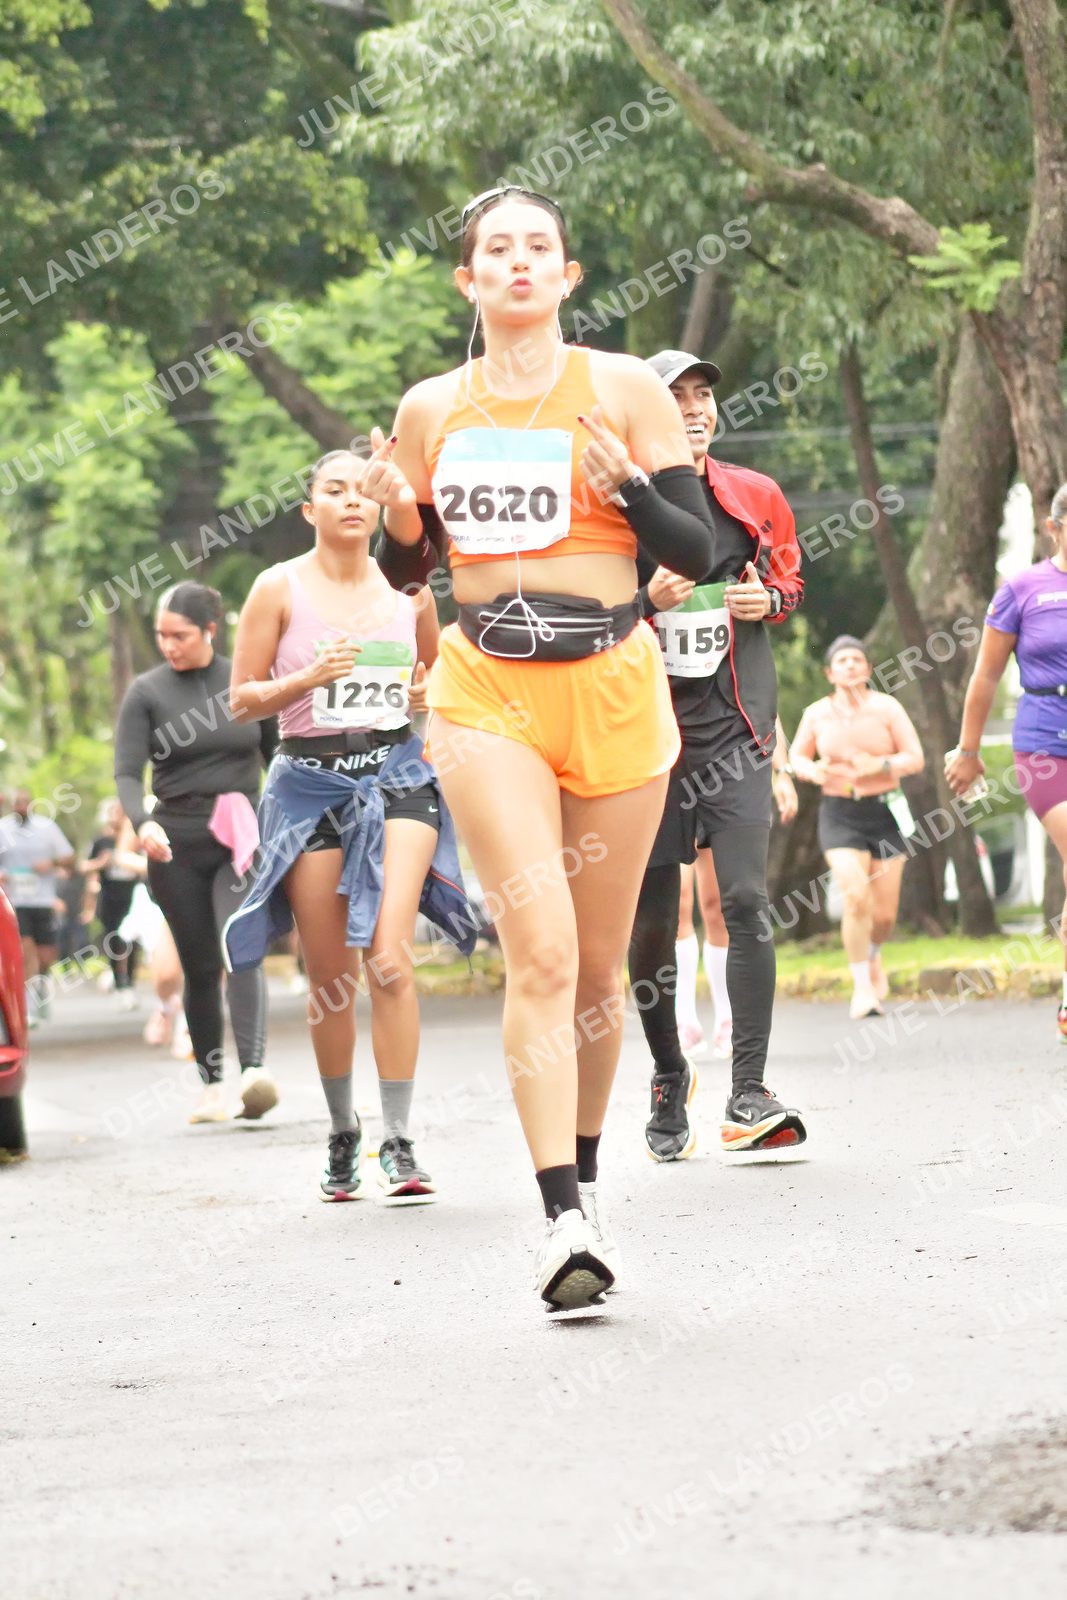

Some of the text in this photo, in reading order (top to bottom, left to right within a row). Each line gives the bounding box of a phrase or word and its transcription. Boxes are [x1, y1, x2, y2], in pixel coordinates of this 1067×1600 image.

[439, 484, 558, 522] 2620
[324, 682, 404, 709] 1226
[333, 744, 391, 771] NIKE
